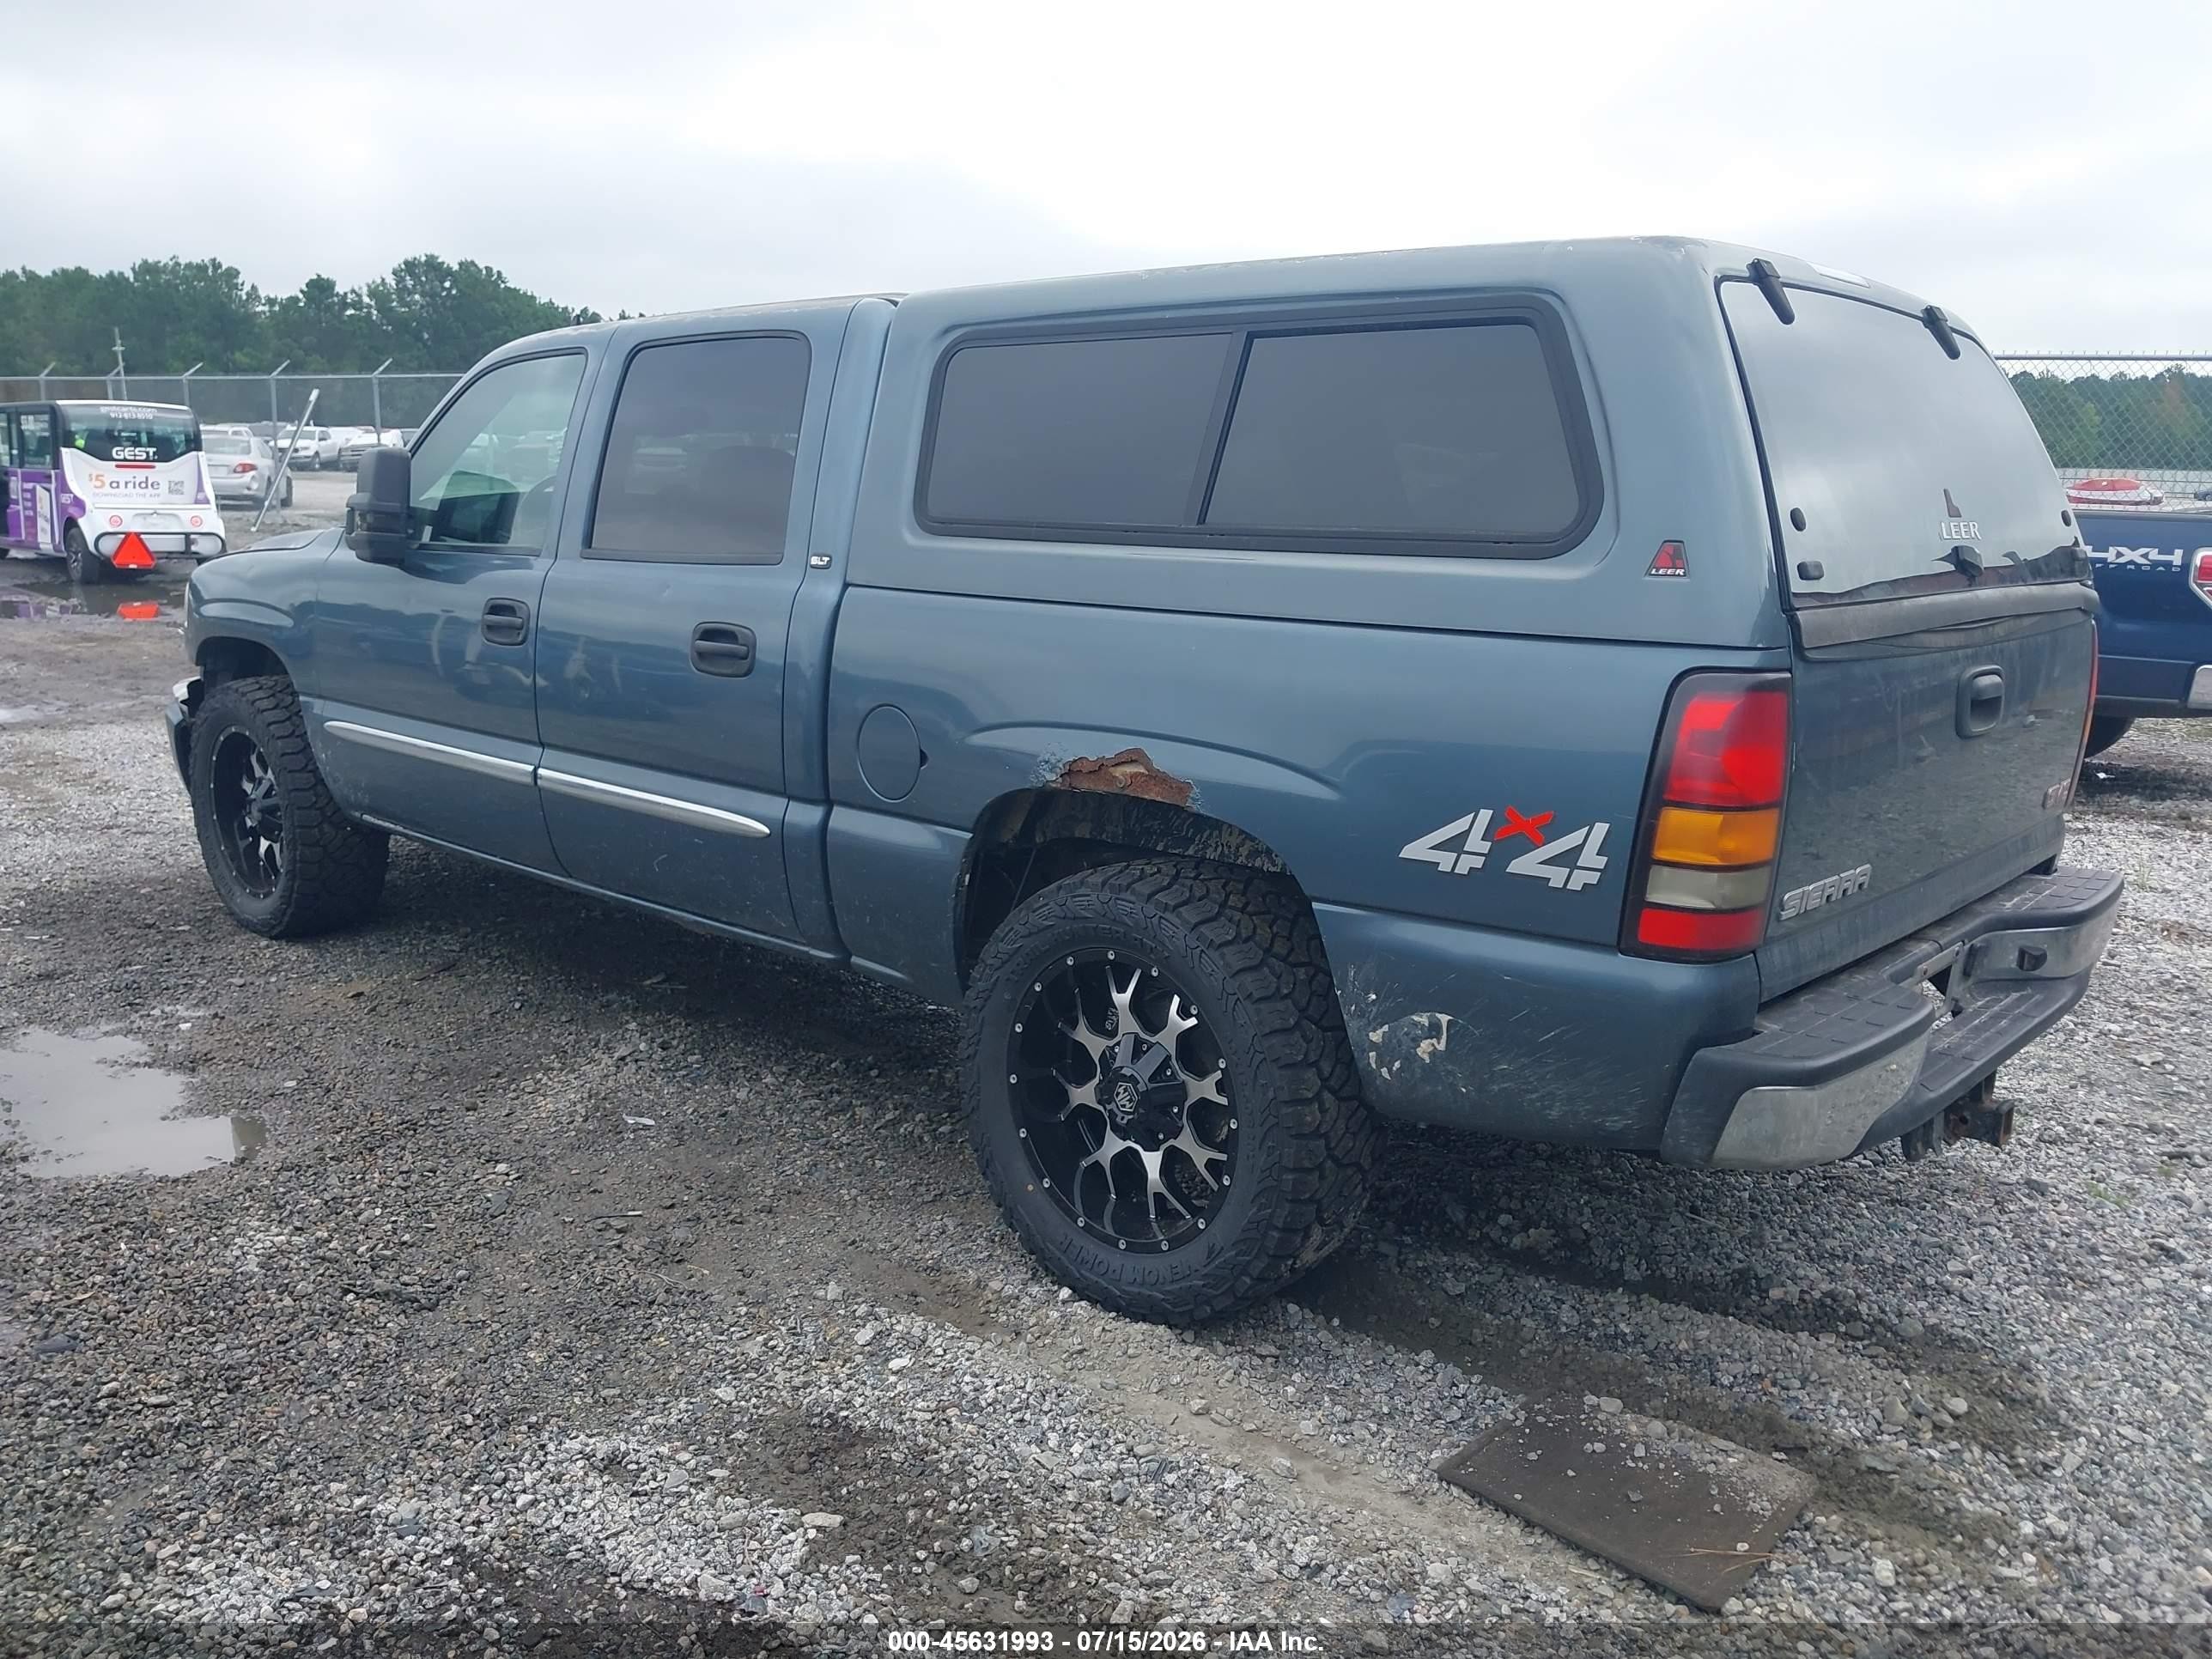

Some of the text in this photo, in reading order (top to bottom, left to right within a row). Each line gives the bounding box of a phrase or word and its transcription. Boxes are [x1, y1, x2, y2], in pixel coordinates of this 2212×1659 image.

[109, 480, 120, 490] a
[125, 476, 161, 490] ride
[1940, 521, 1983, 541] LEER
[810, 556, 830, 566] SLT
[1779, 863, 1872, 921] SIERRA
